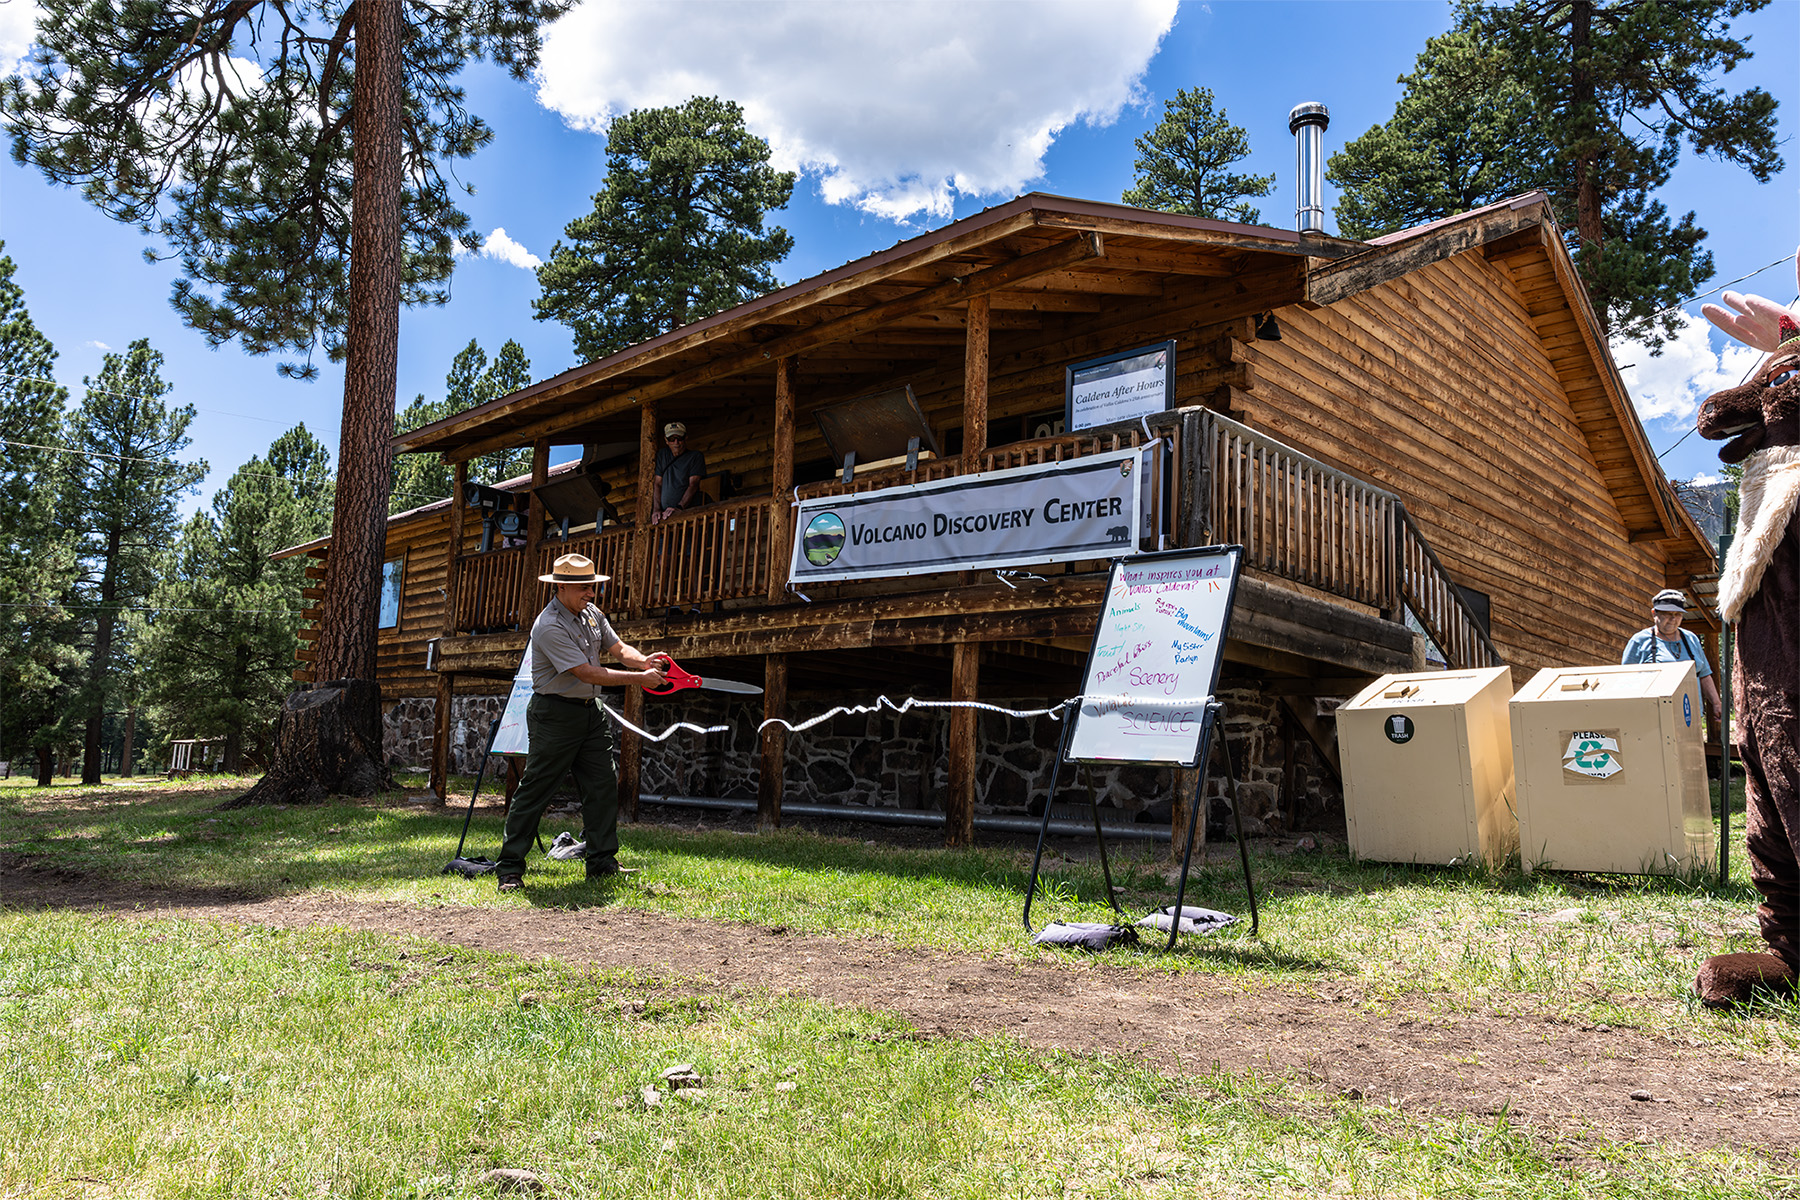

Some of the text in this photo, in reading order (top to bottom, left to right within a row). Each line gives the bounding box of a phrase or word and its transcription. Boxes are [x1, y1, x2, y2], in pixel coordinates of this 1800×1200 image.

[1075, 378, 1165, 405] Caldera After Hours
[851, 521, 927, 546] VOLCANO
[933, 507, 1035, 538] DISCOVERY
[1043, 496, 1123, 525] CENTER
[1119, 564, 1220, 582] What inspires you at
[1109, 602, 1141, 618] Animals
[1174, 606, 1189, 621] Big
[1171, 639, 1182, 654] My
[1129, 666, 1179, 695] Scenery
[1118, 710, 1195, 733] SCIENCE
